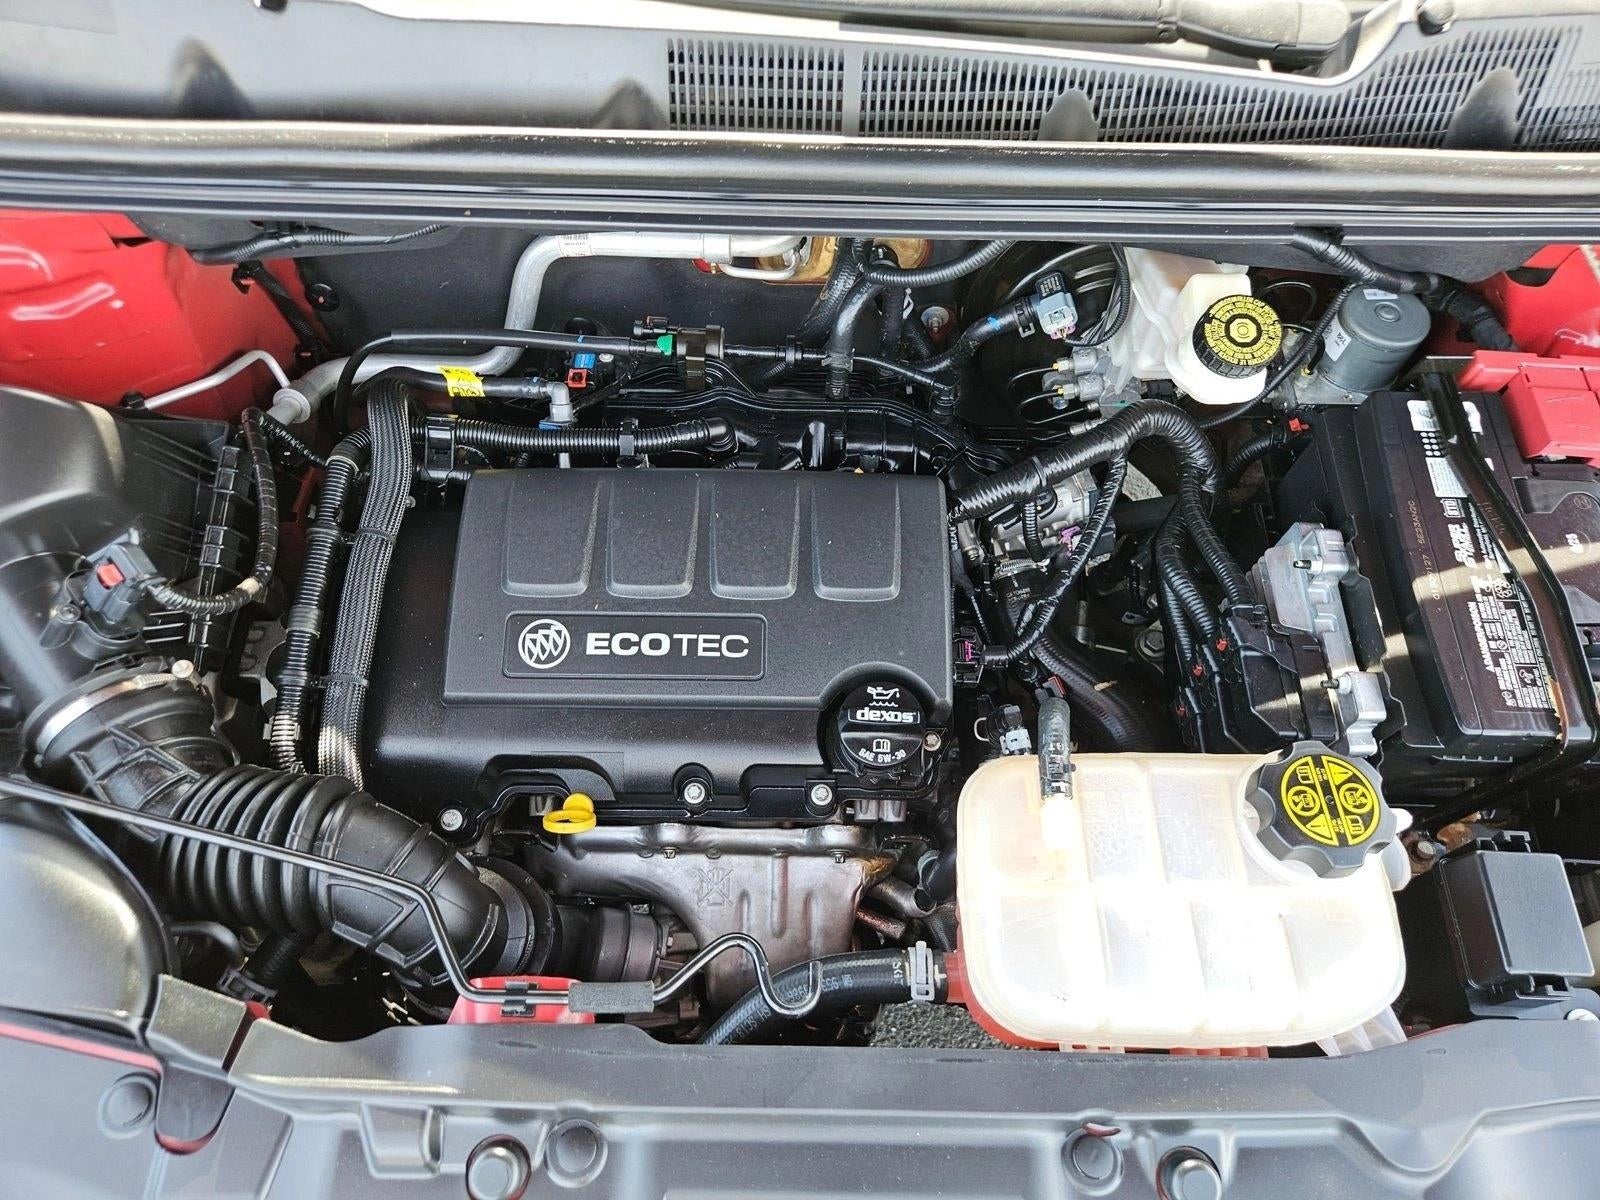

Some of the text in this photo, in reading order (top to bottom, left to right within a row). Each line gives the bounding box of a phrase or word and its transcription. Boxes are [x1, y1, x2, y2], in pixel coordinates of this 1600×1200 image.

[585, 631, 750, 660] ECOTEC
[856, 707, 915, 723] dexos
[858, 748, 906, 763] SAE 5W-30
